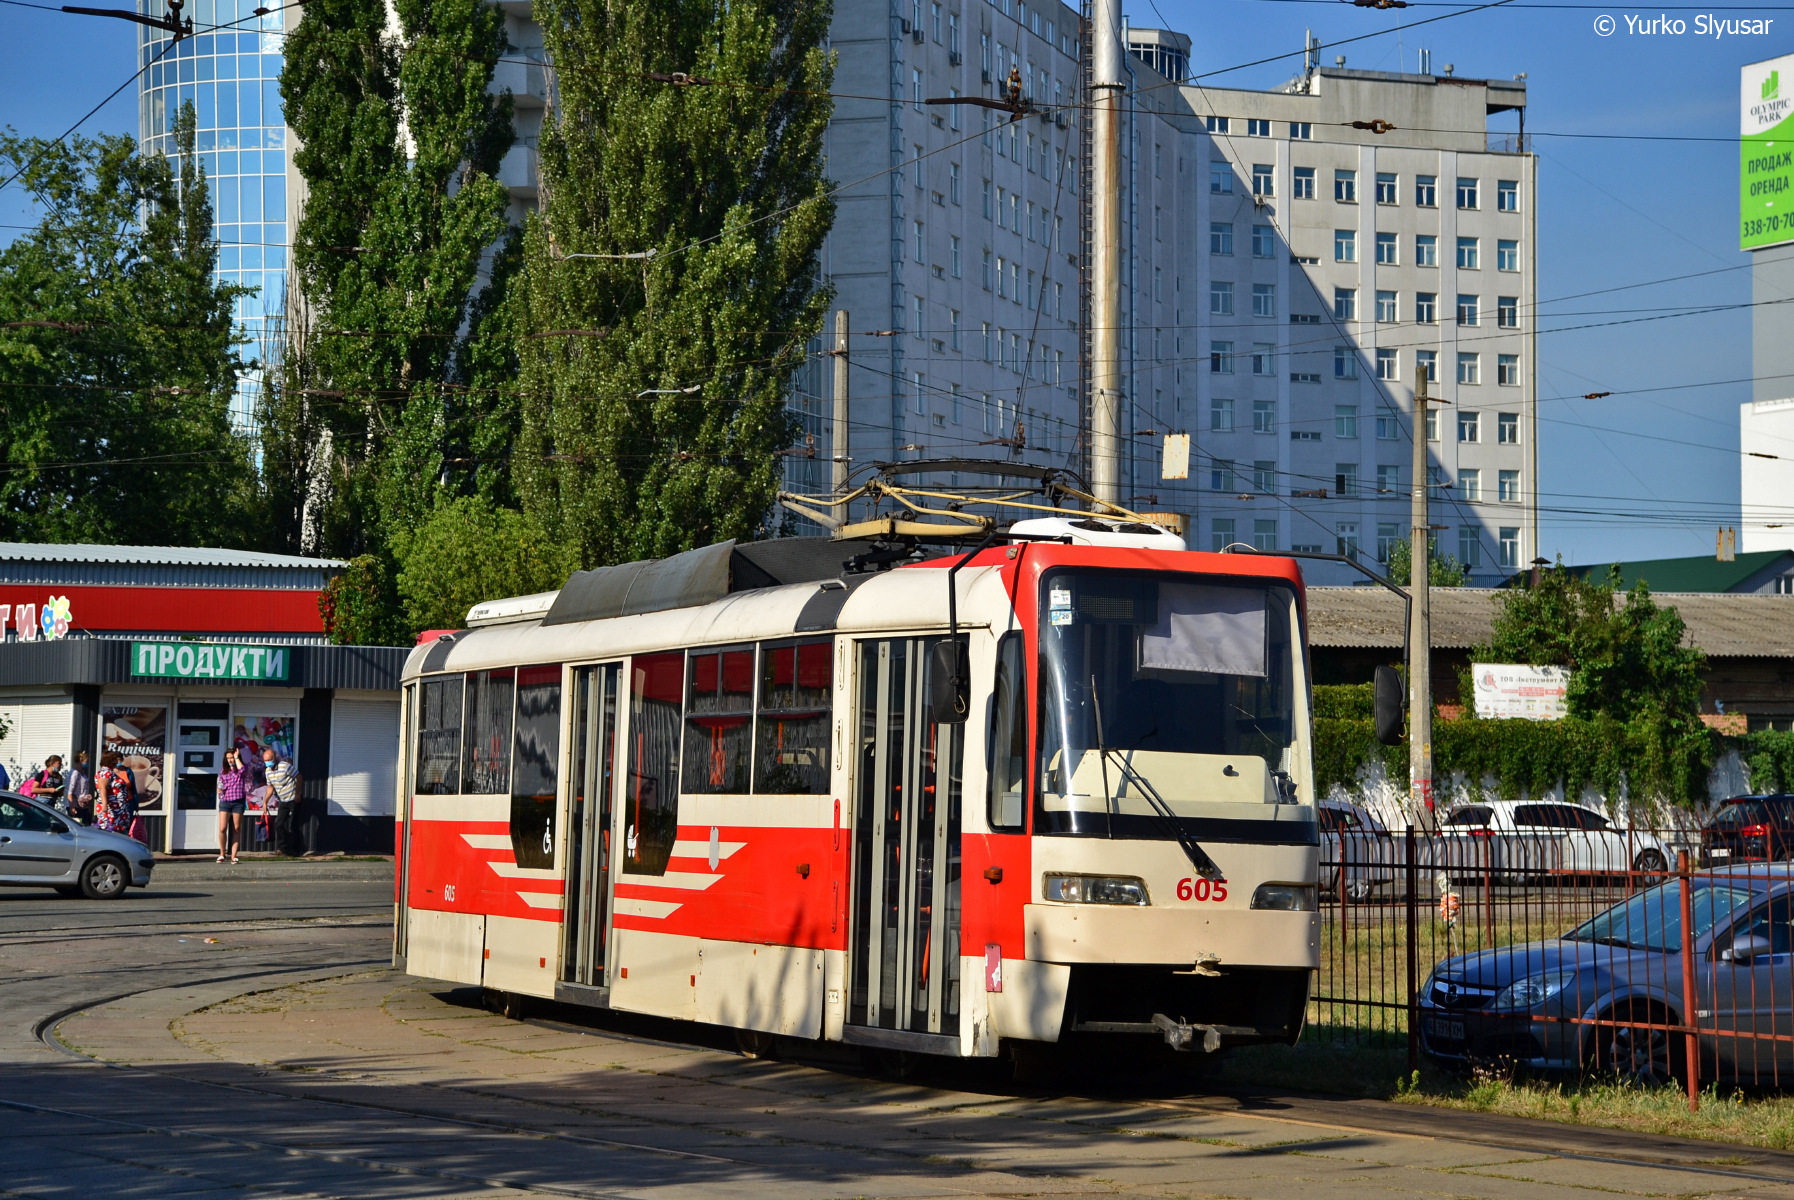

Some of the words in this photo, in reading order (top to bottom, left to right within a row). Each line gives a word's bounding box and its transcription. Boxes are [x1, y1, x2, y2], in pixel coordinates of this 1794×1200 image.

[1750, 98, 1791, 117] OLYMPIC
[1758, 110, 1782, 125] PARK
[1748, 151, 1792, 174] ПРОДАЖ
[1750, 175, 1790, 197] ОРЕНДА
[138, 644, 284, 678] ПРОДУКТИ
[107, 742, 161, 755] Випічка
[444, 884, 456, 902] 605
[1176, 877, 1228, 902] 605
